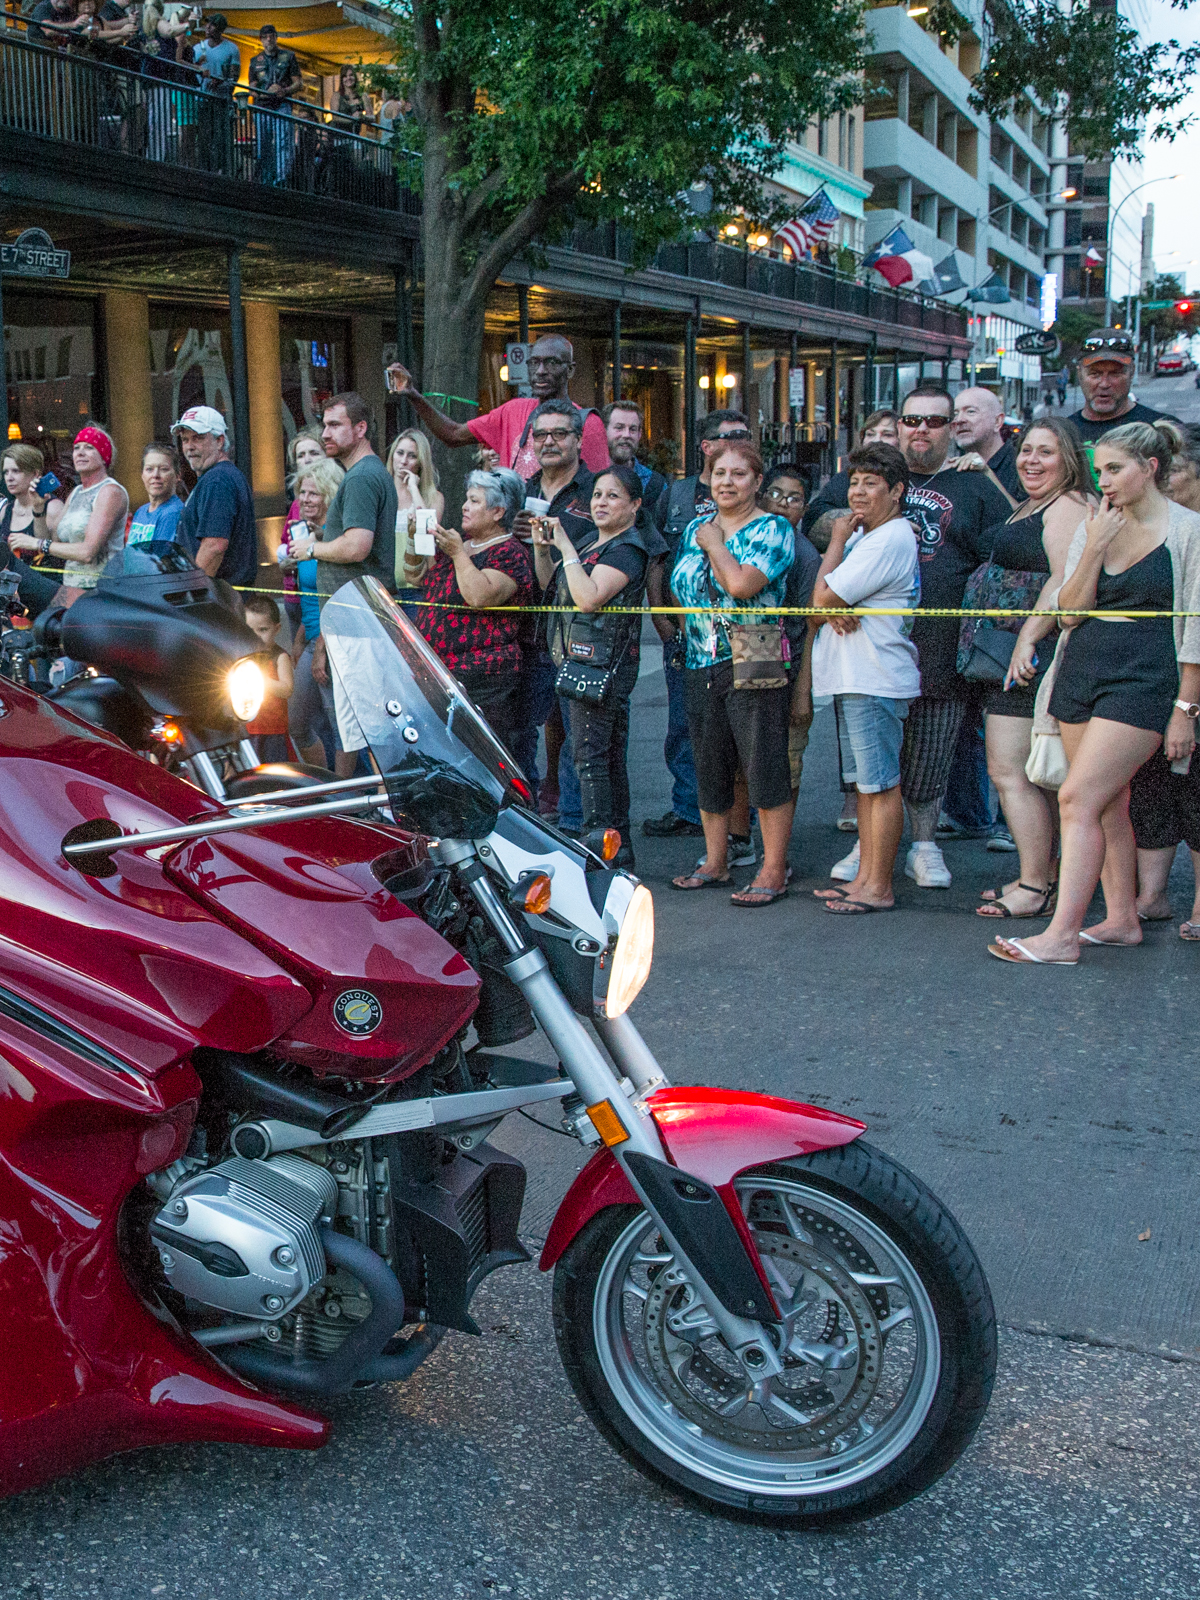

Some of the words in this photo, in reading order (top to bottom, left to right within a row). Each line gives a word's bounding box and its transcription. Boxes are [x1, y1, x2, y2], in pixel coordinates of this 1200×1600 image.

[1, 247, 10, 263] E
[26, 250, 67, 268] STREET
[337, 992, 379, 1018] CONQUEST
